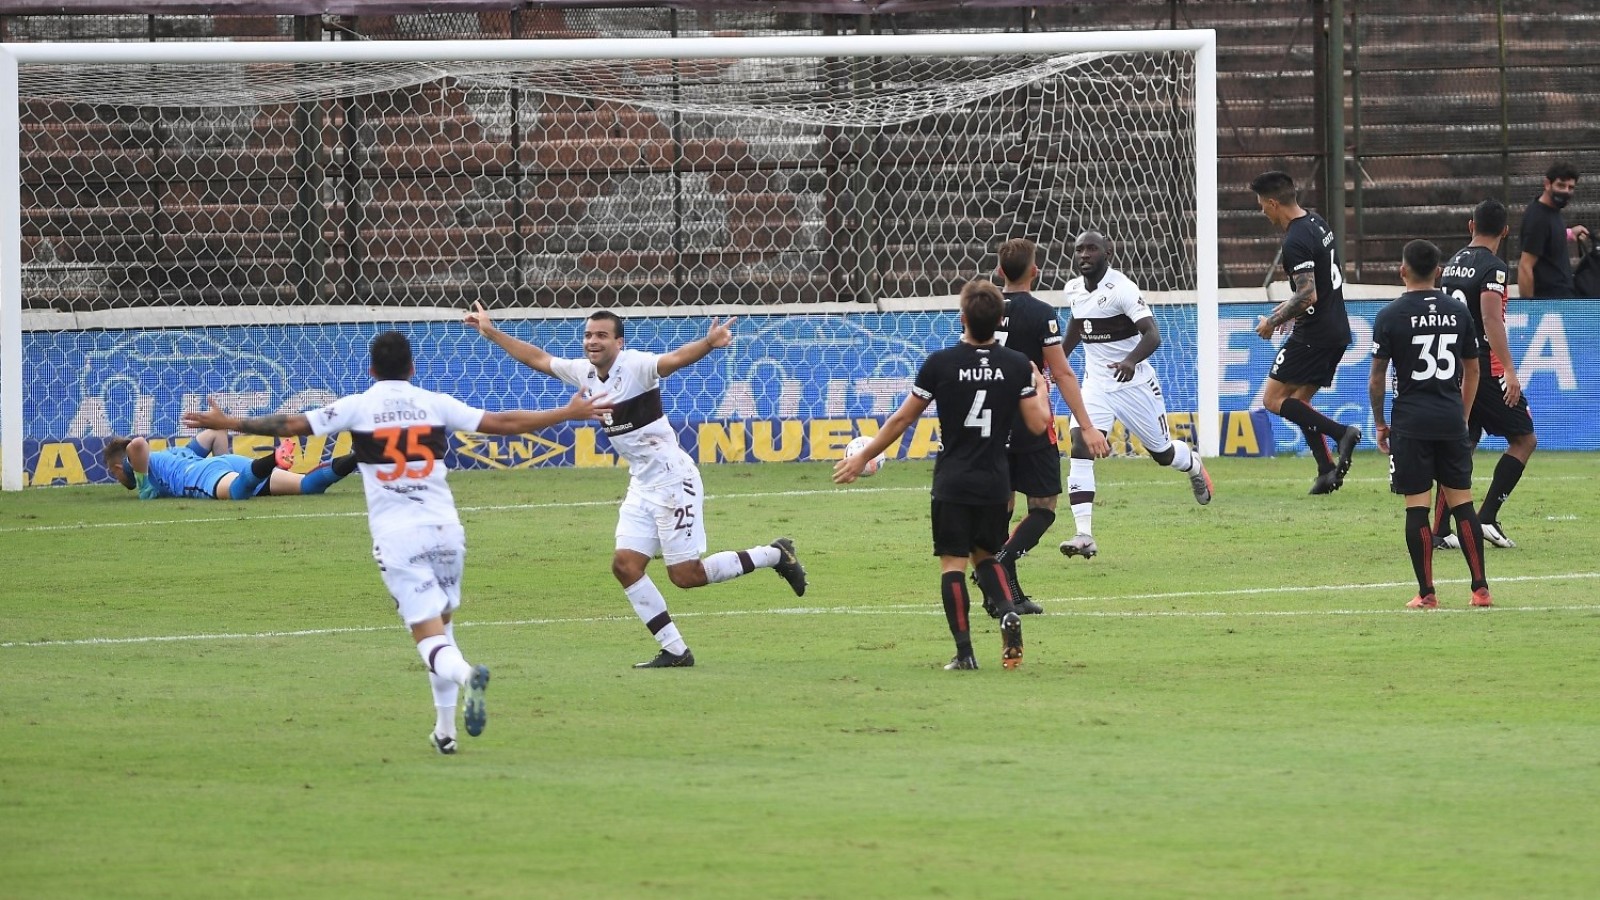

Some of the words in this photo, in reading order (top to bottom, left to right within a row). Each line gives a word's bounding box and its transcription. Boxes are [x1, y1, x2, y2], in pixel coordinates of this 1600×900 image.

[1330, 248, 1342, 290] 6
[1442, 265, 1476, 278] ELGADO
[1410, 314, 1457, 328] FARIAS
[1275, 349, 1287, 365] 6
[1410, 333, 1458, 381] 35
[959, 368, 1005, 381] MURA
[373, 409, 427, 424] BERTOLO
[963, 389, 993, 438] 4
[1157, 412, 1168, 436] 11
[372, 425, 435, 482] 35
[488, 440, 534, 459] LN
[673, 504, 695, 531] 25
